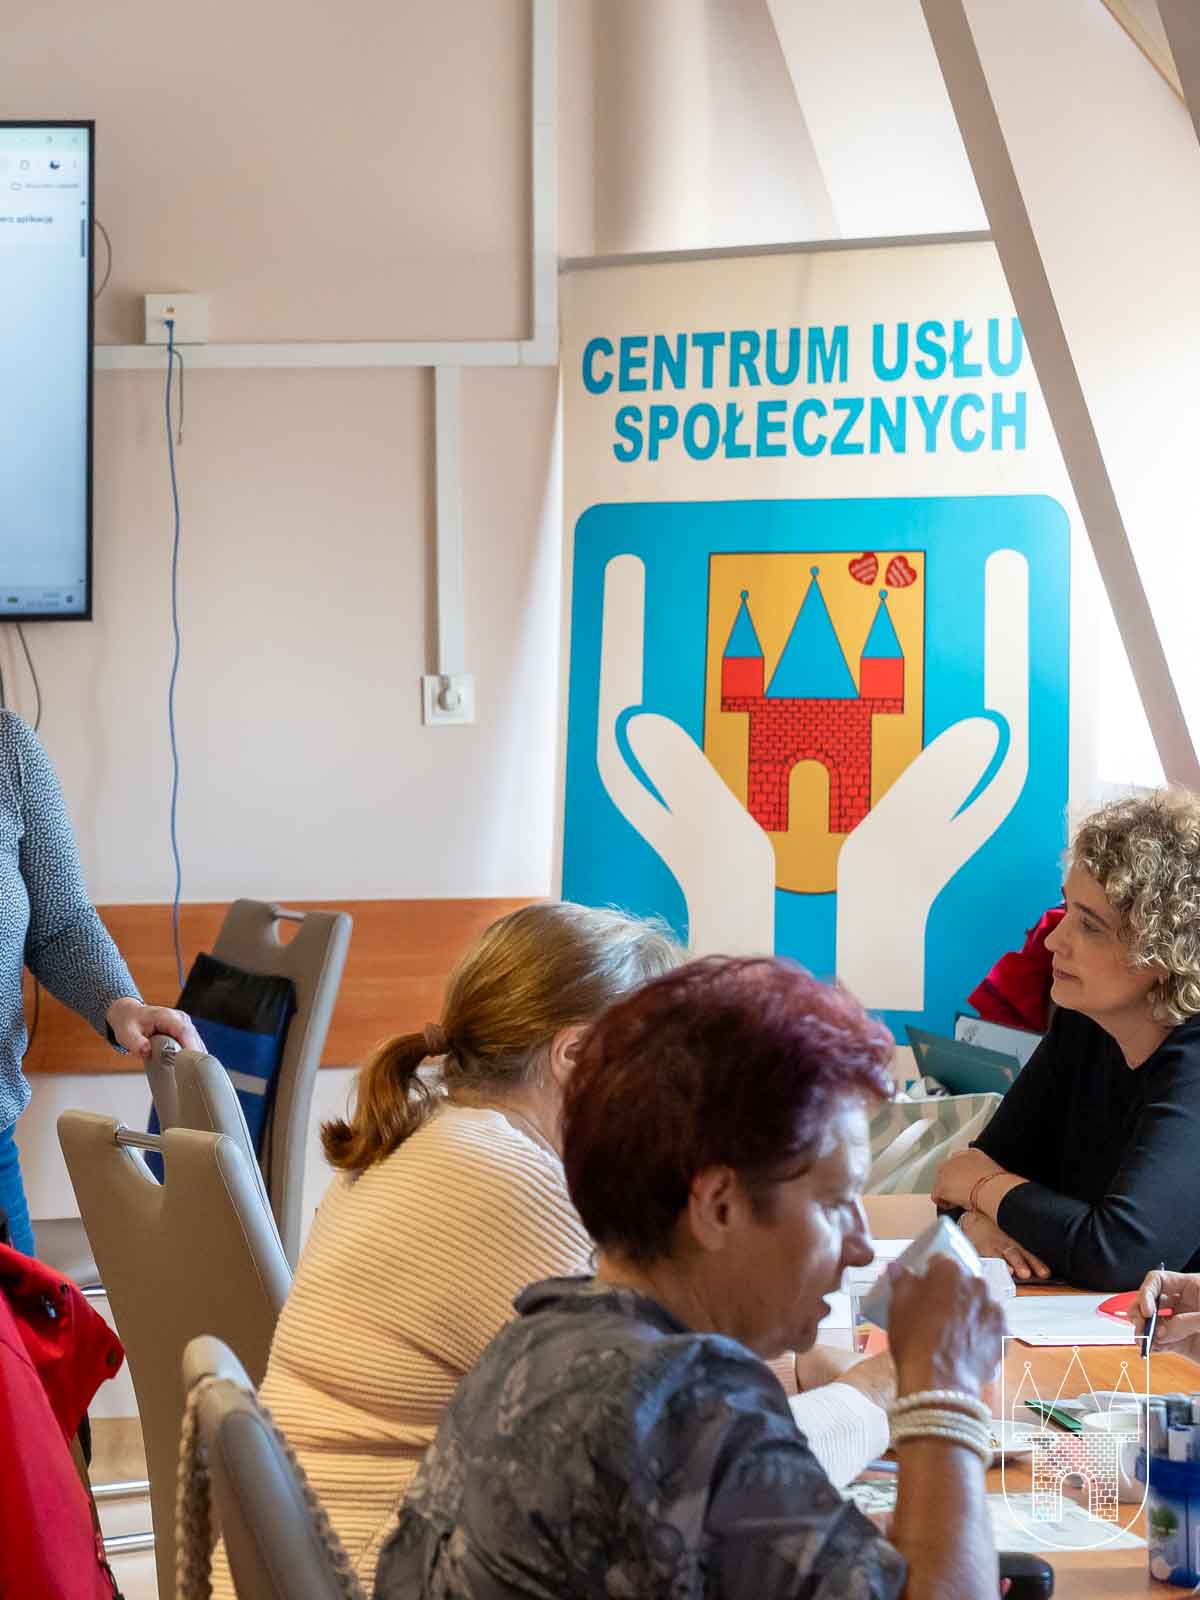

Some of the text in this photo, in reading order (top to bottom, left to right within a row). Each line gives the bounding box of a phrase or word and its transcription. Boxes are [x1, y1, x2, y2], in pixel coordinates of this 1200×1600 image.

[582, 317, 1024, 395] CENTRUM USŁU
[612, 391, 1027, 463] SPOŁECZNYCH
